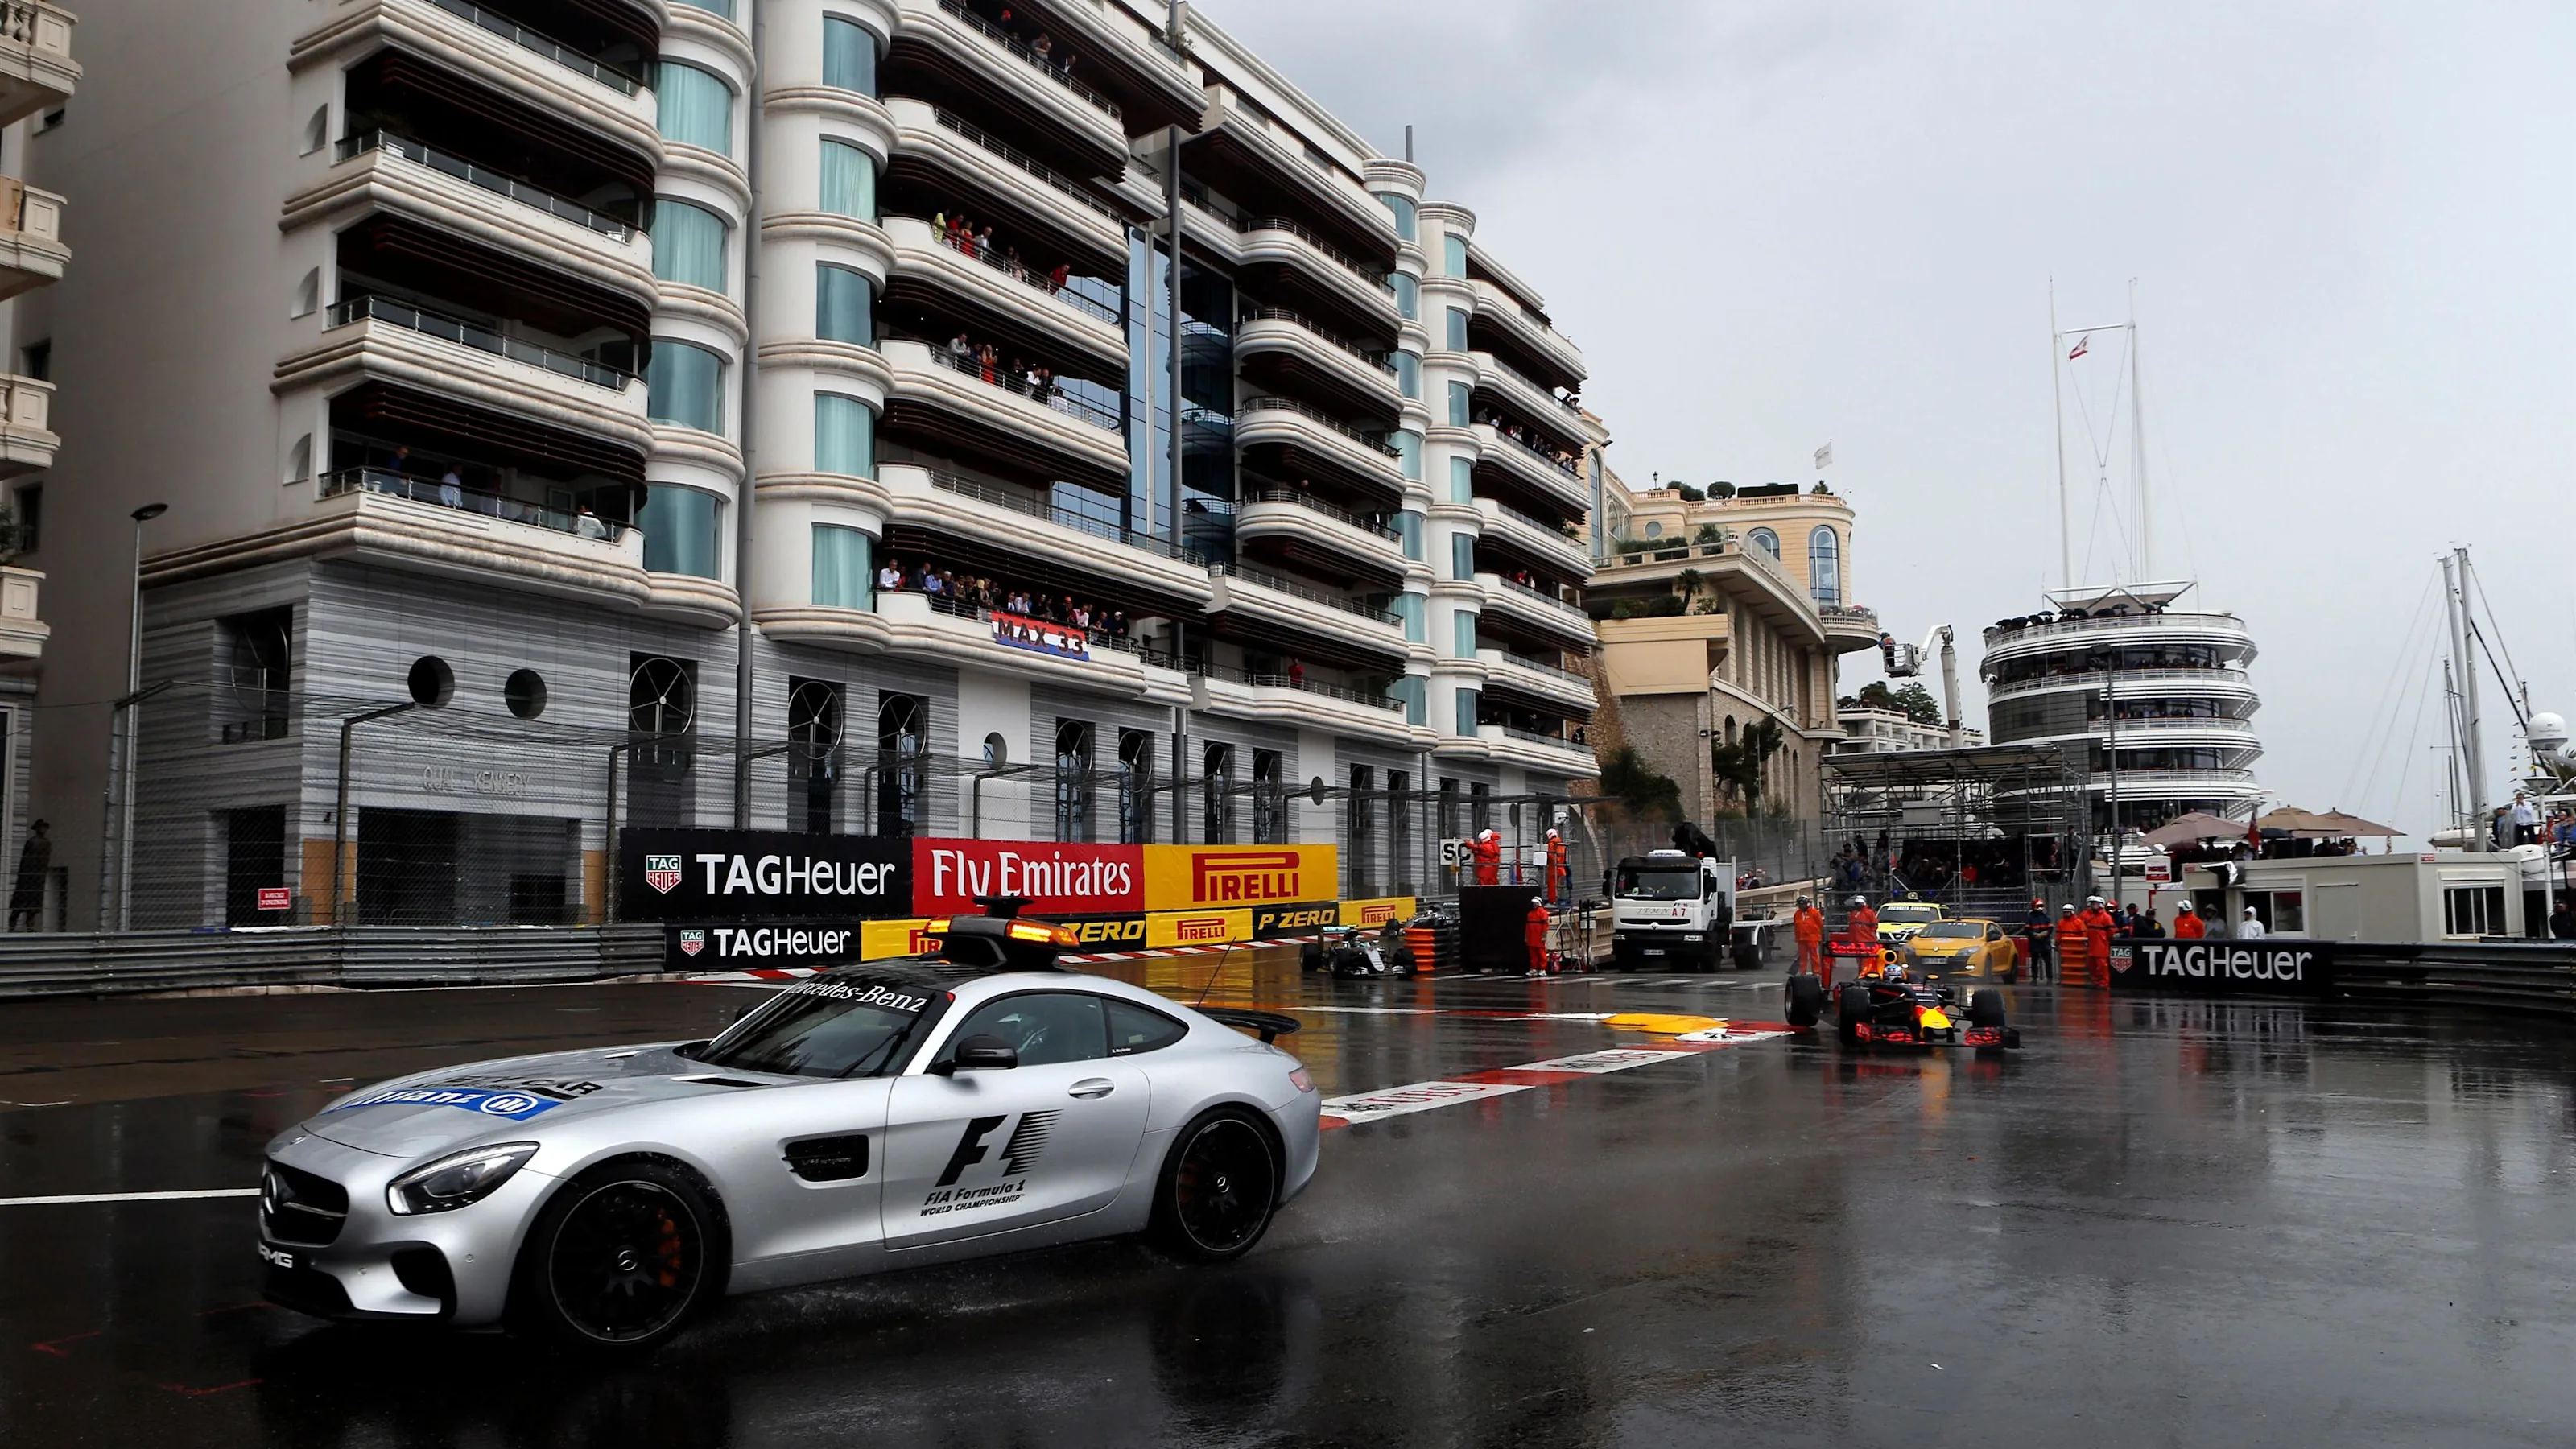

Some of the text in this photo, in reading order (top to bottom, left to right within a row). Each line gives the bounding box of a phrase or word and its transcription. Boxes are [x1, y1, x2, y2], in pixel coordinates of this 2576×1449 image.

[997, 617, 1083, 655] MAX 33
[423, 766, 453, 791] QUAI
[649, 857, 679, 869] TAG
[648, 872, 679, 891] HEUER
[931, 849, 1131, 907] Fly Emirates
[1192, 851, 1300, 902] PIRELLI
[1257, 909, 1335, 931] P ZERO
[1361, 904, 1396, 924] PIRELLI
[683, 932, 702, 940] TAG
[1177, 917, 1225, 941] PIRELLI
[2112, 948, 2131, 957] TAG
[1358, 1086, 1486, 1104] UBS
[935, 1109, 1064, 1187] F1
[924, 1179, 1026, 1206] FIA Formula 1
[920, 1204, 952, 1216] WORLD
